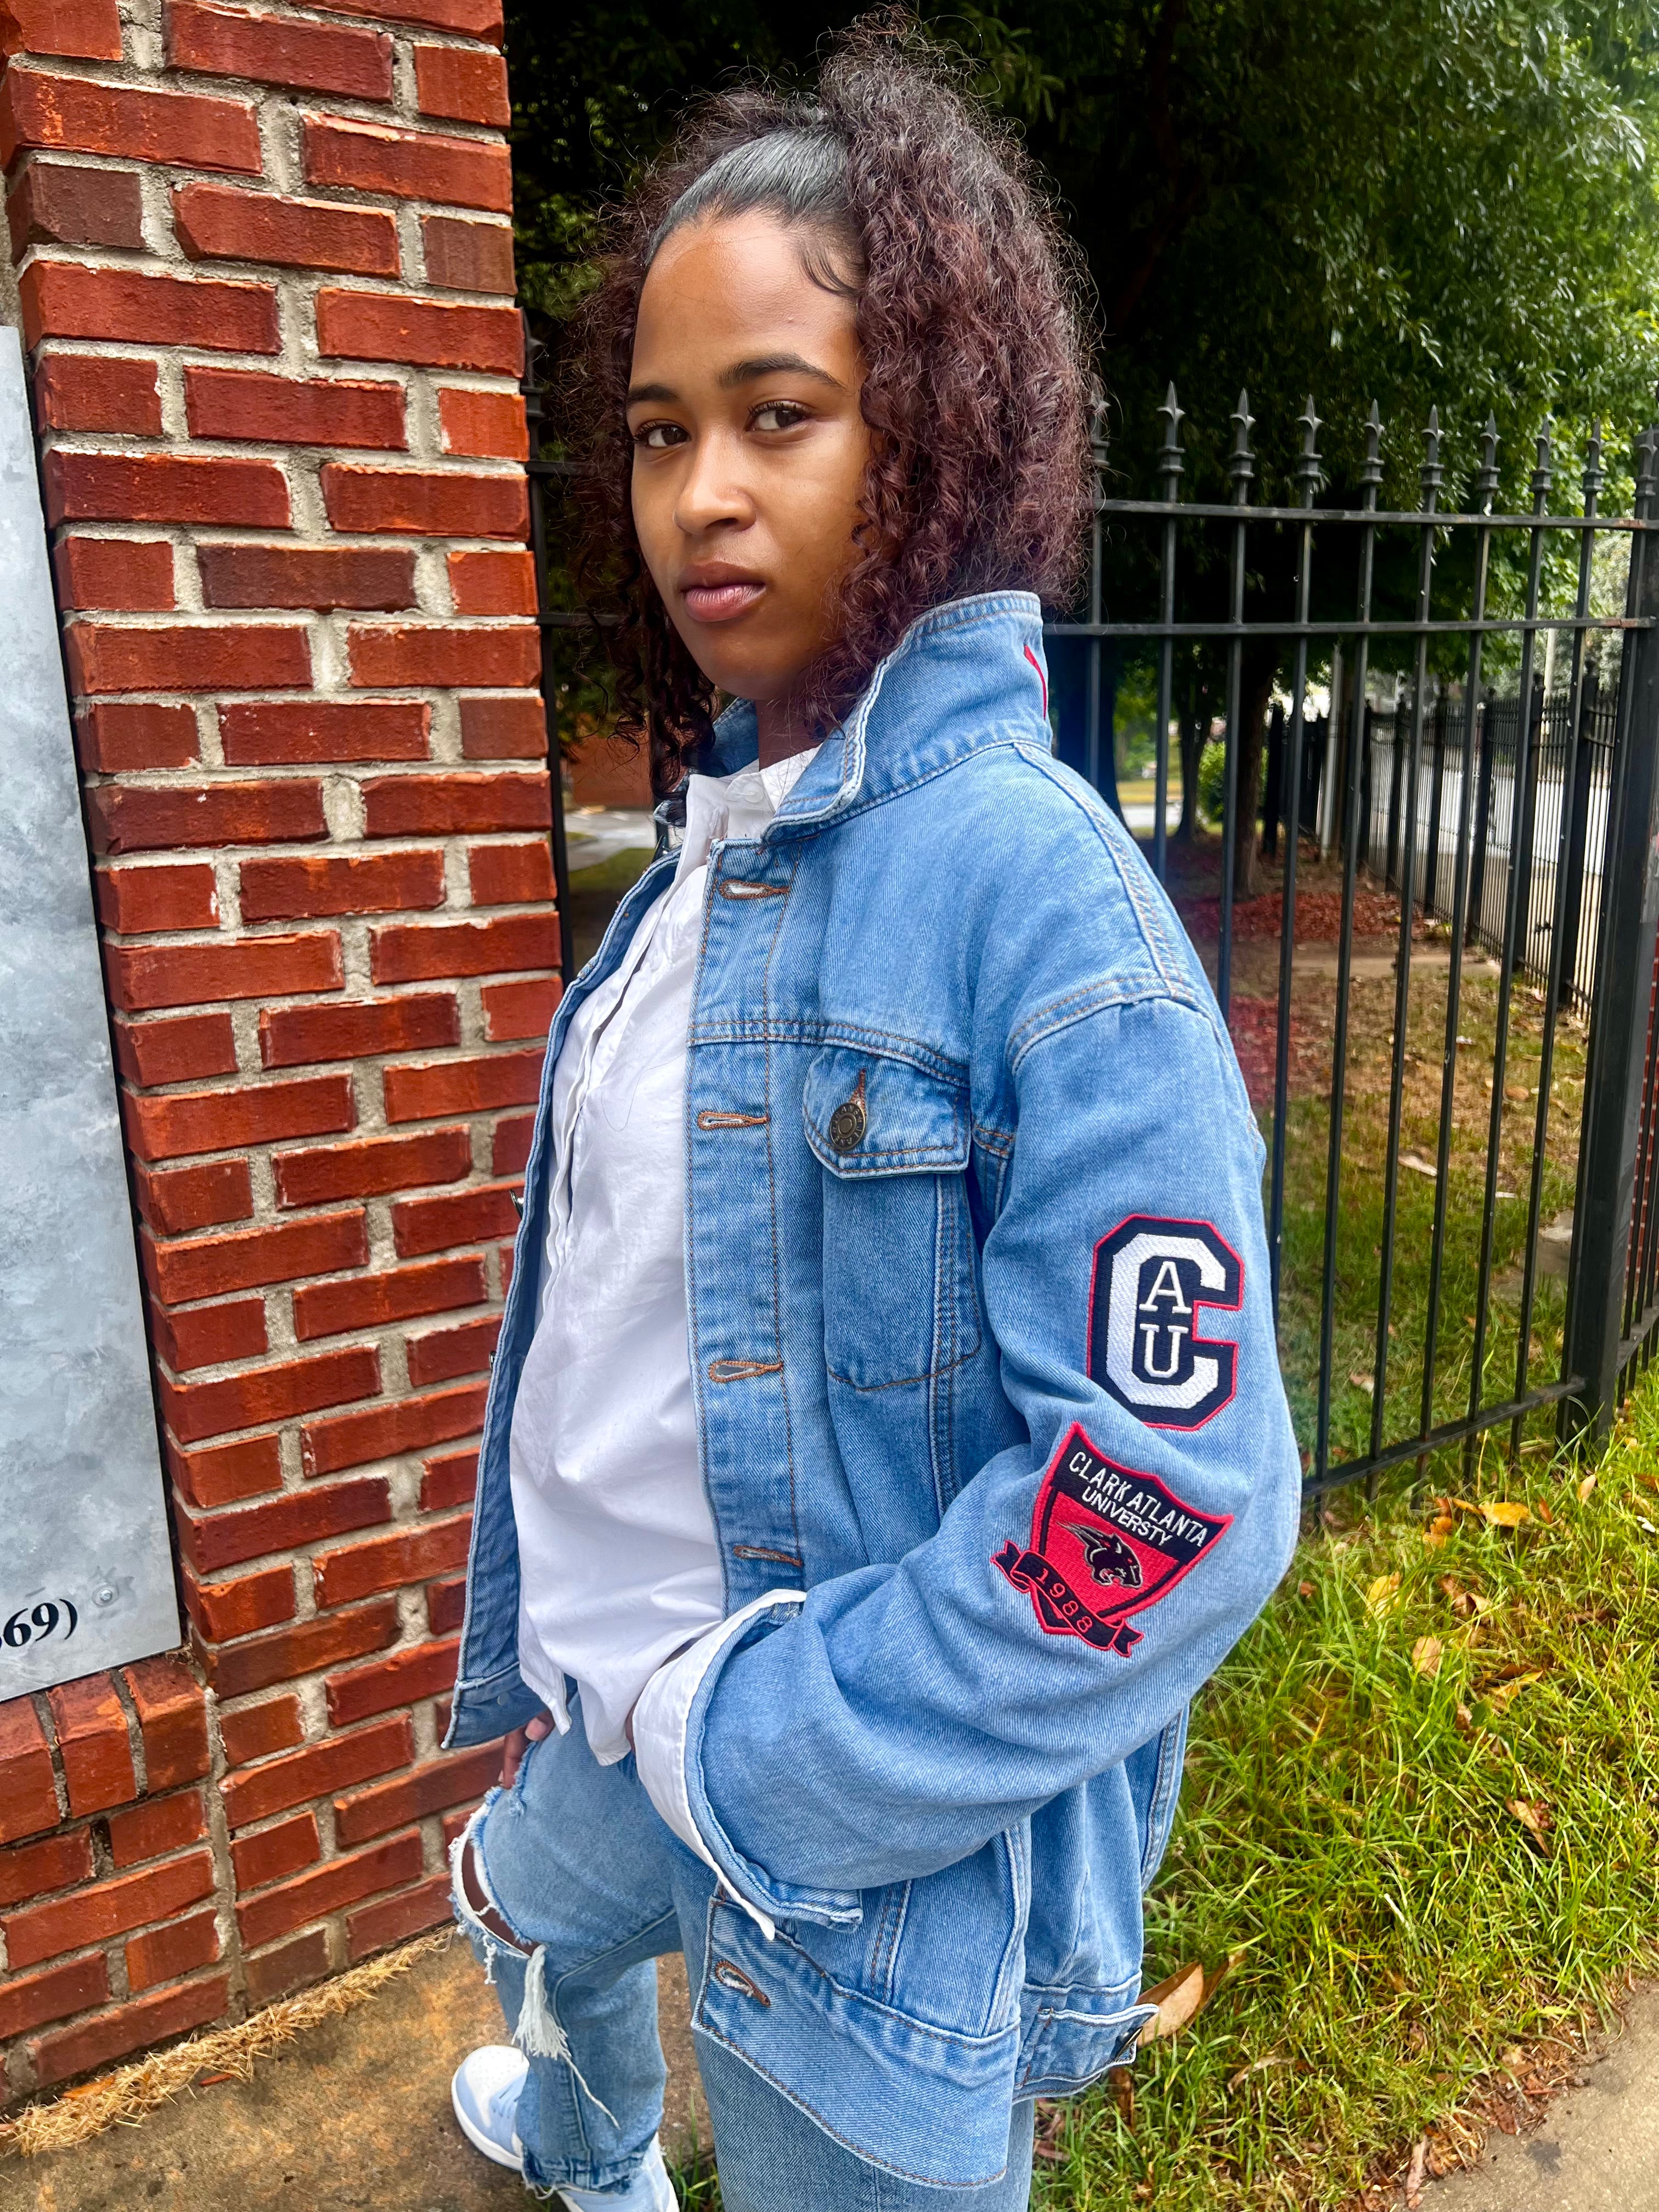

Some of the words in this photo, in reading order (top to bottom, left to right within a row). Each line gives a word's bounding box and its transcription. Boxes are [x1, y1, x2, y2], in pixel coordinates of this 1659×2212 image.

[1069, 1451, 1132, 1502] CLARK
[1126, 1491, 1209, 1547] ATLANTA
[1081, 1485, 1173, 1546] UNIVERSTY
[0, 1599, 78, 1647] 69)
[1036, 1567, 1093, 1634] 1988
